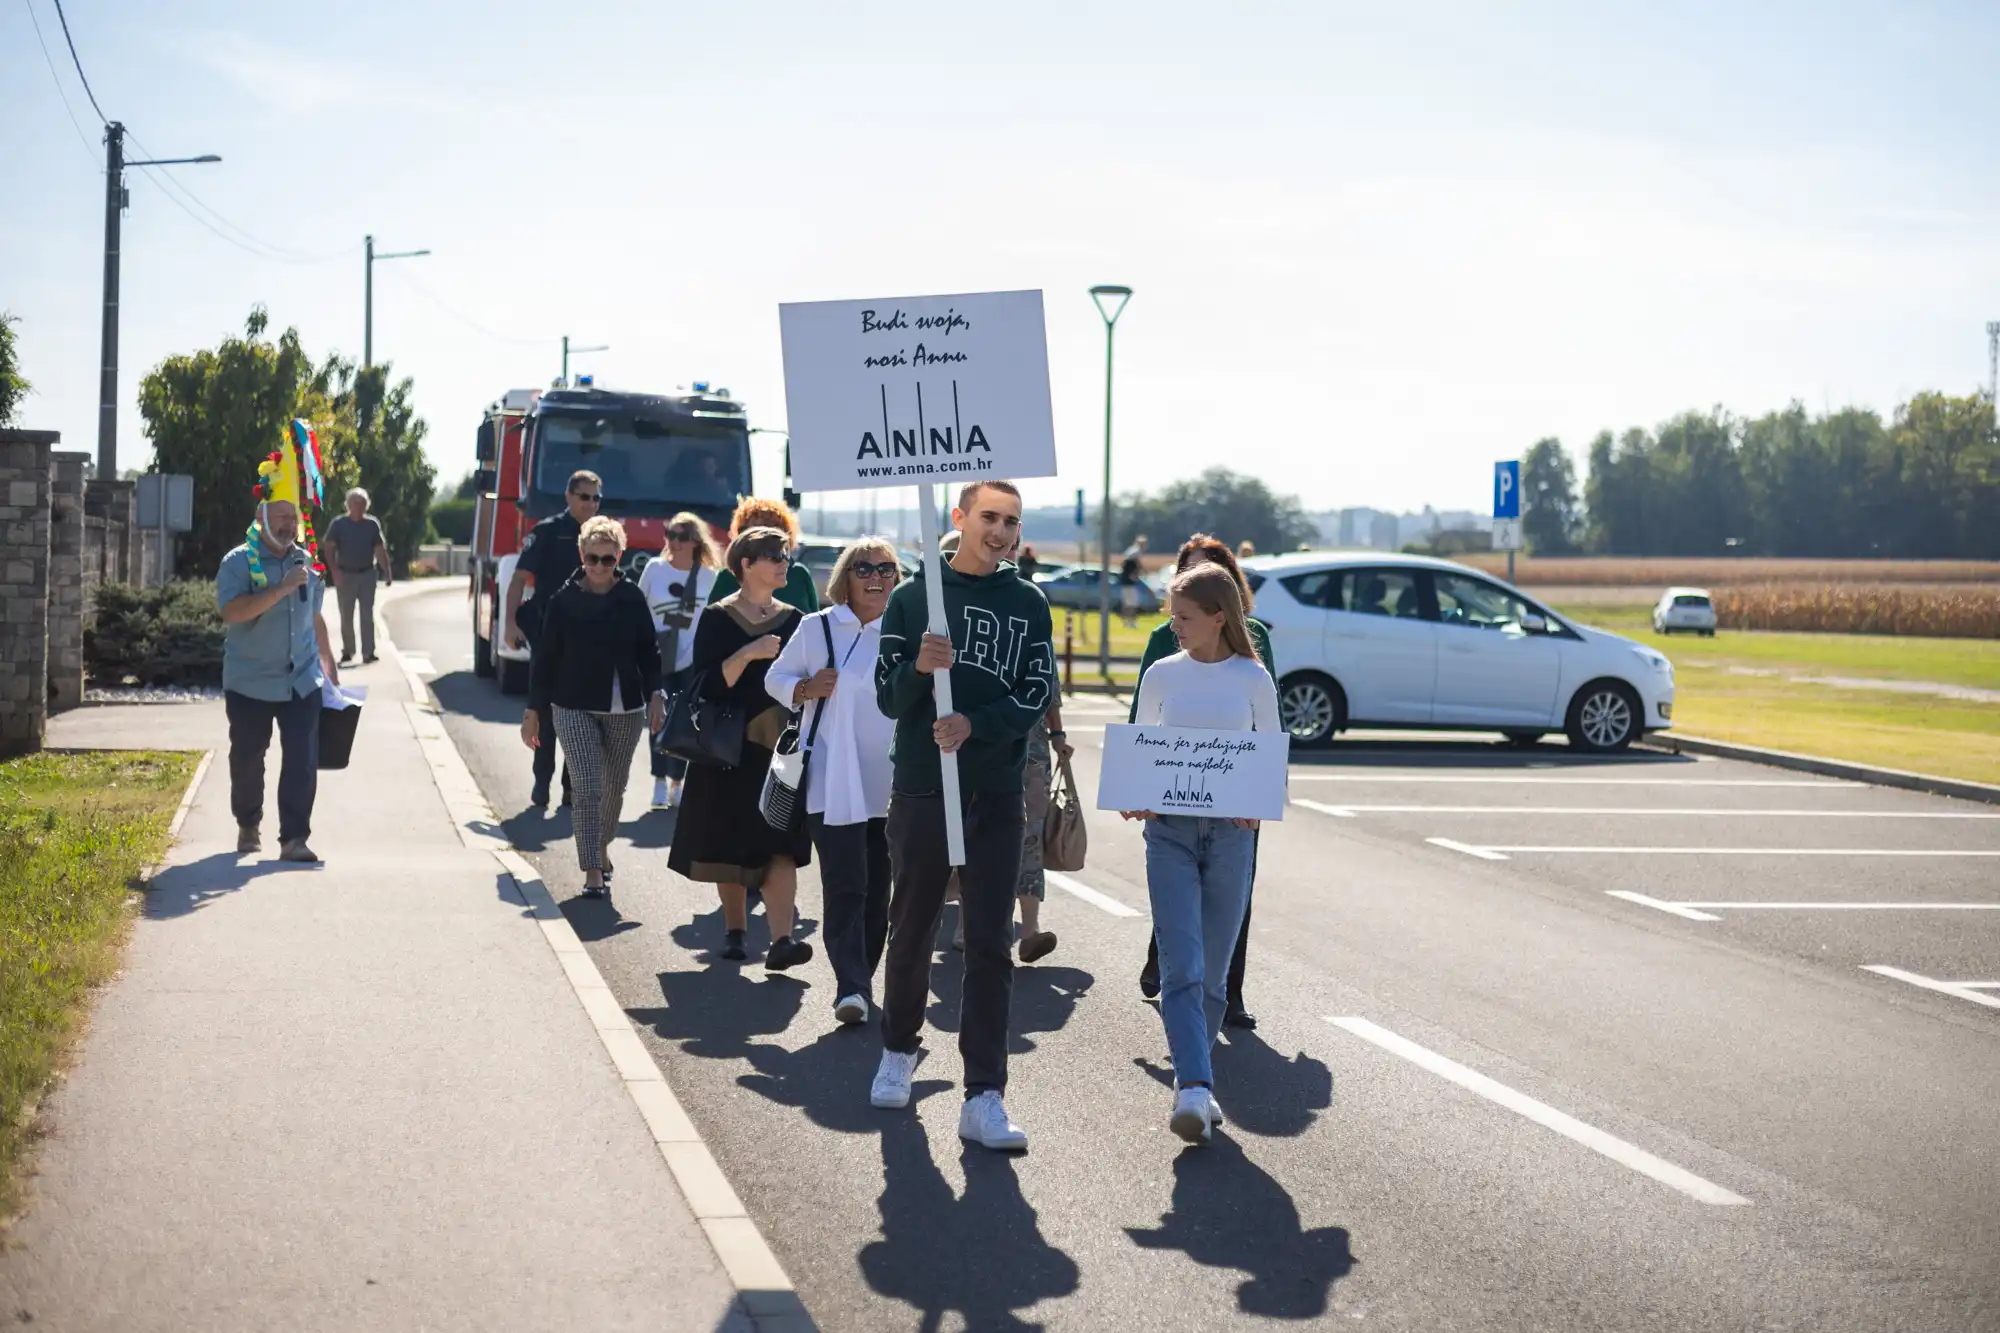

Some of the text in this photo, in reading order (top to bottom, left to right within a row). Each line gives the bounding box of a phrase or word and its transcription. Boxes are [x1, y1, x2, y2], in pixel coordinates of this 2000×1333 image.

[861, 308, 970, 336] Budi svoja,
[864, 343, 968, 369] nosi Annu
[857, 458, 993, 478] www.anna.com.hr
[1500, 470, 1512, 507] P
[1135, 732, 1256, 755] Anna, jer zaslužujete
[1154, 757, 1234, 775] samo najbolje
